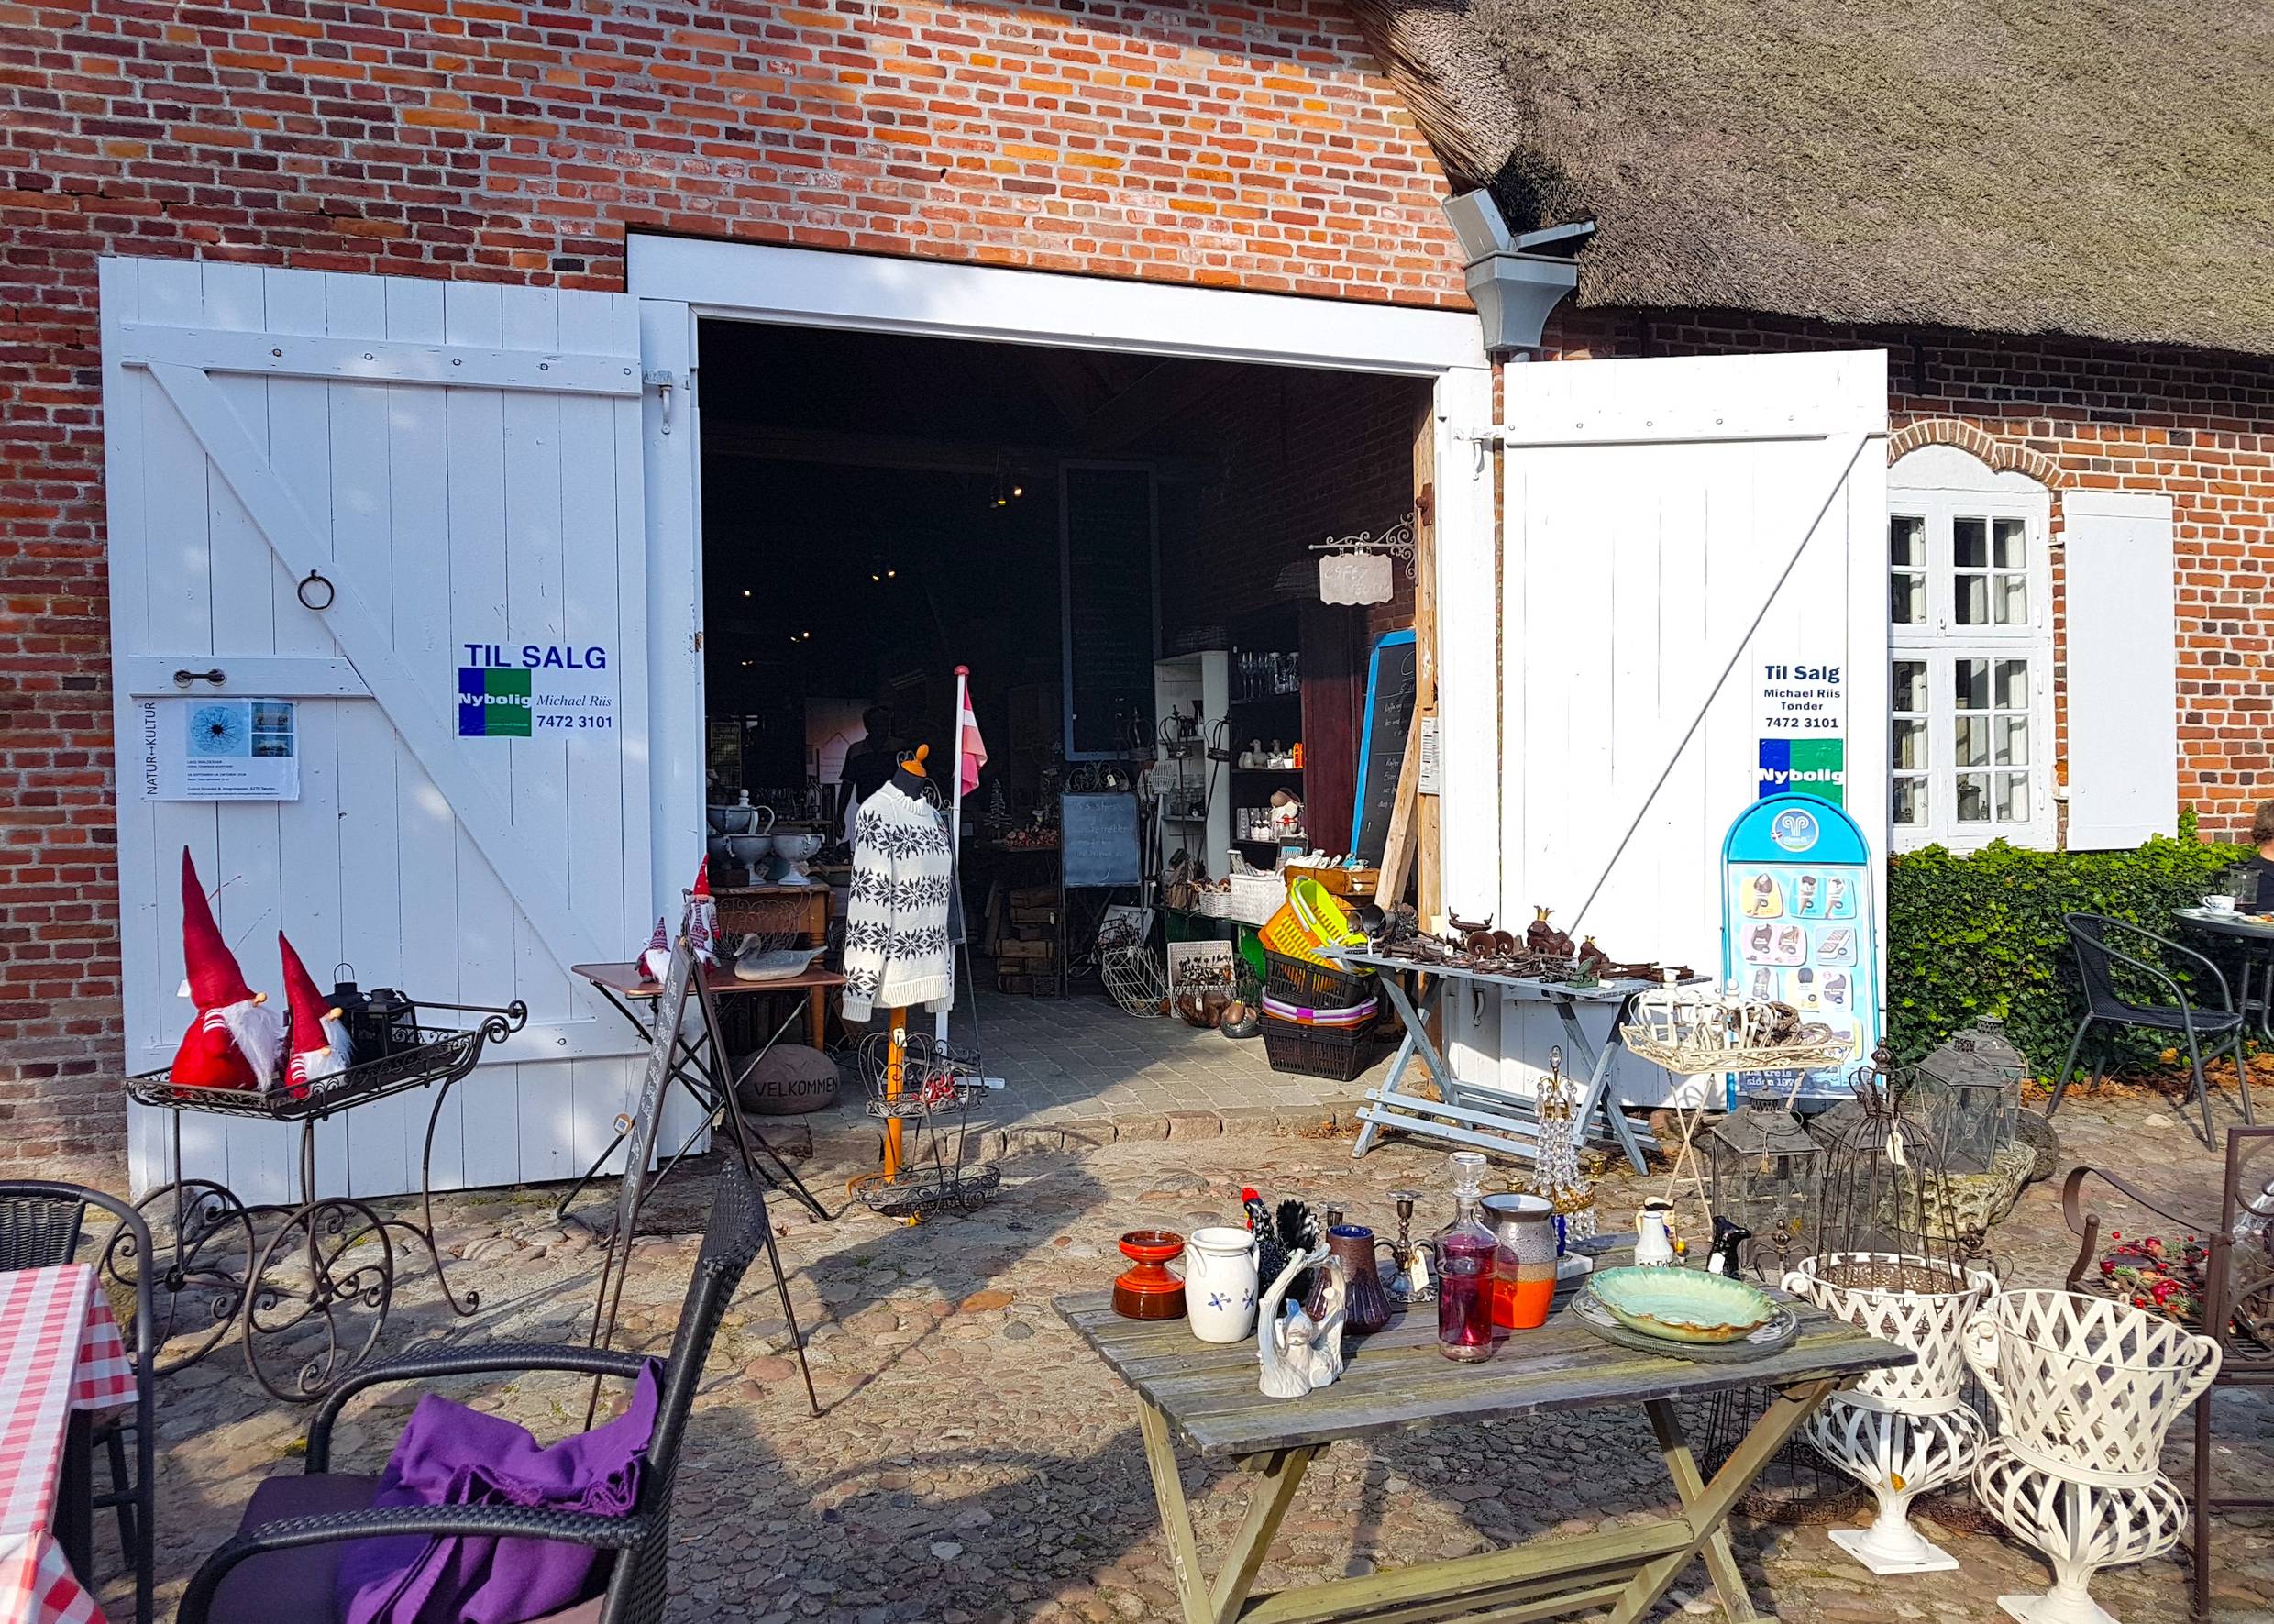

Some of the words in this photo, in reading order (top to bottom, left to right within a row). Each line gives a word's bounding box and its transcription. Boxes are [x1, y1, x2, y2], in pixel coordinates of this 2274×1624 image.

[464, 644, 512, 668] TIL
[522, 645, 607, 670] SALG
[1764, 665, 1788, 680] Til
[1794, 665, 1841, 684] Salg
[458, 692, 533, 709] Nybolig
[535, 694, 587, 707] Michael
[589, 694, 613, 707] Riis
[1763, 688, 1813, 698] Michael
[1816, 689, 1841, 698] Riis
[535, 715, 574, 728] 7472
[577, 715, 613, 728] 3101
[1765, 717, 1799, 728] 7472
[1804, 717, 1839, 728] 3101
[1758, 768, 1844, 786] Nybolig
[754, 1077, 838, 1098] VELKOMMEN
